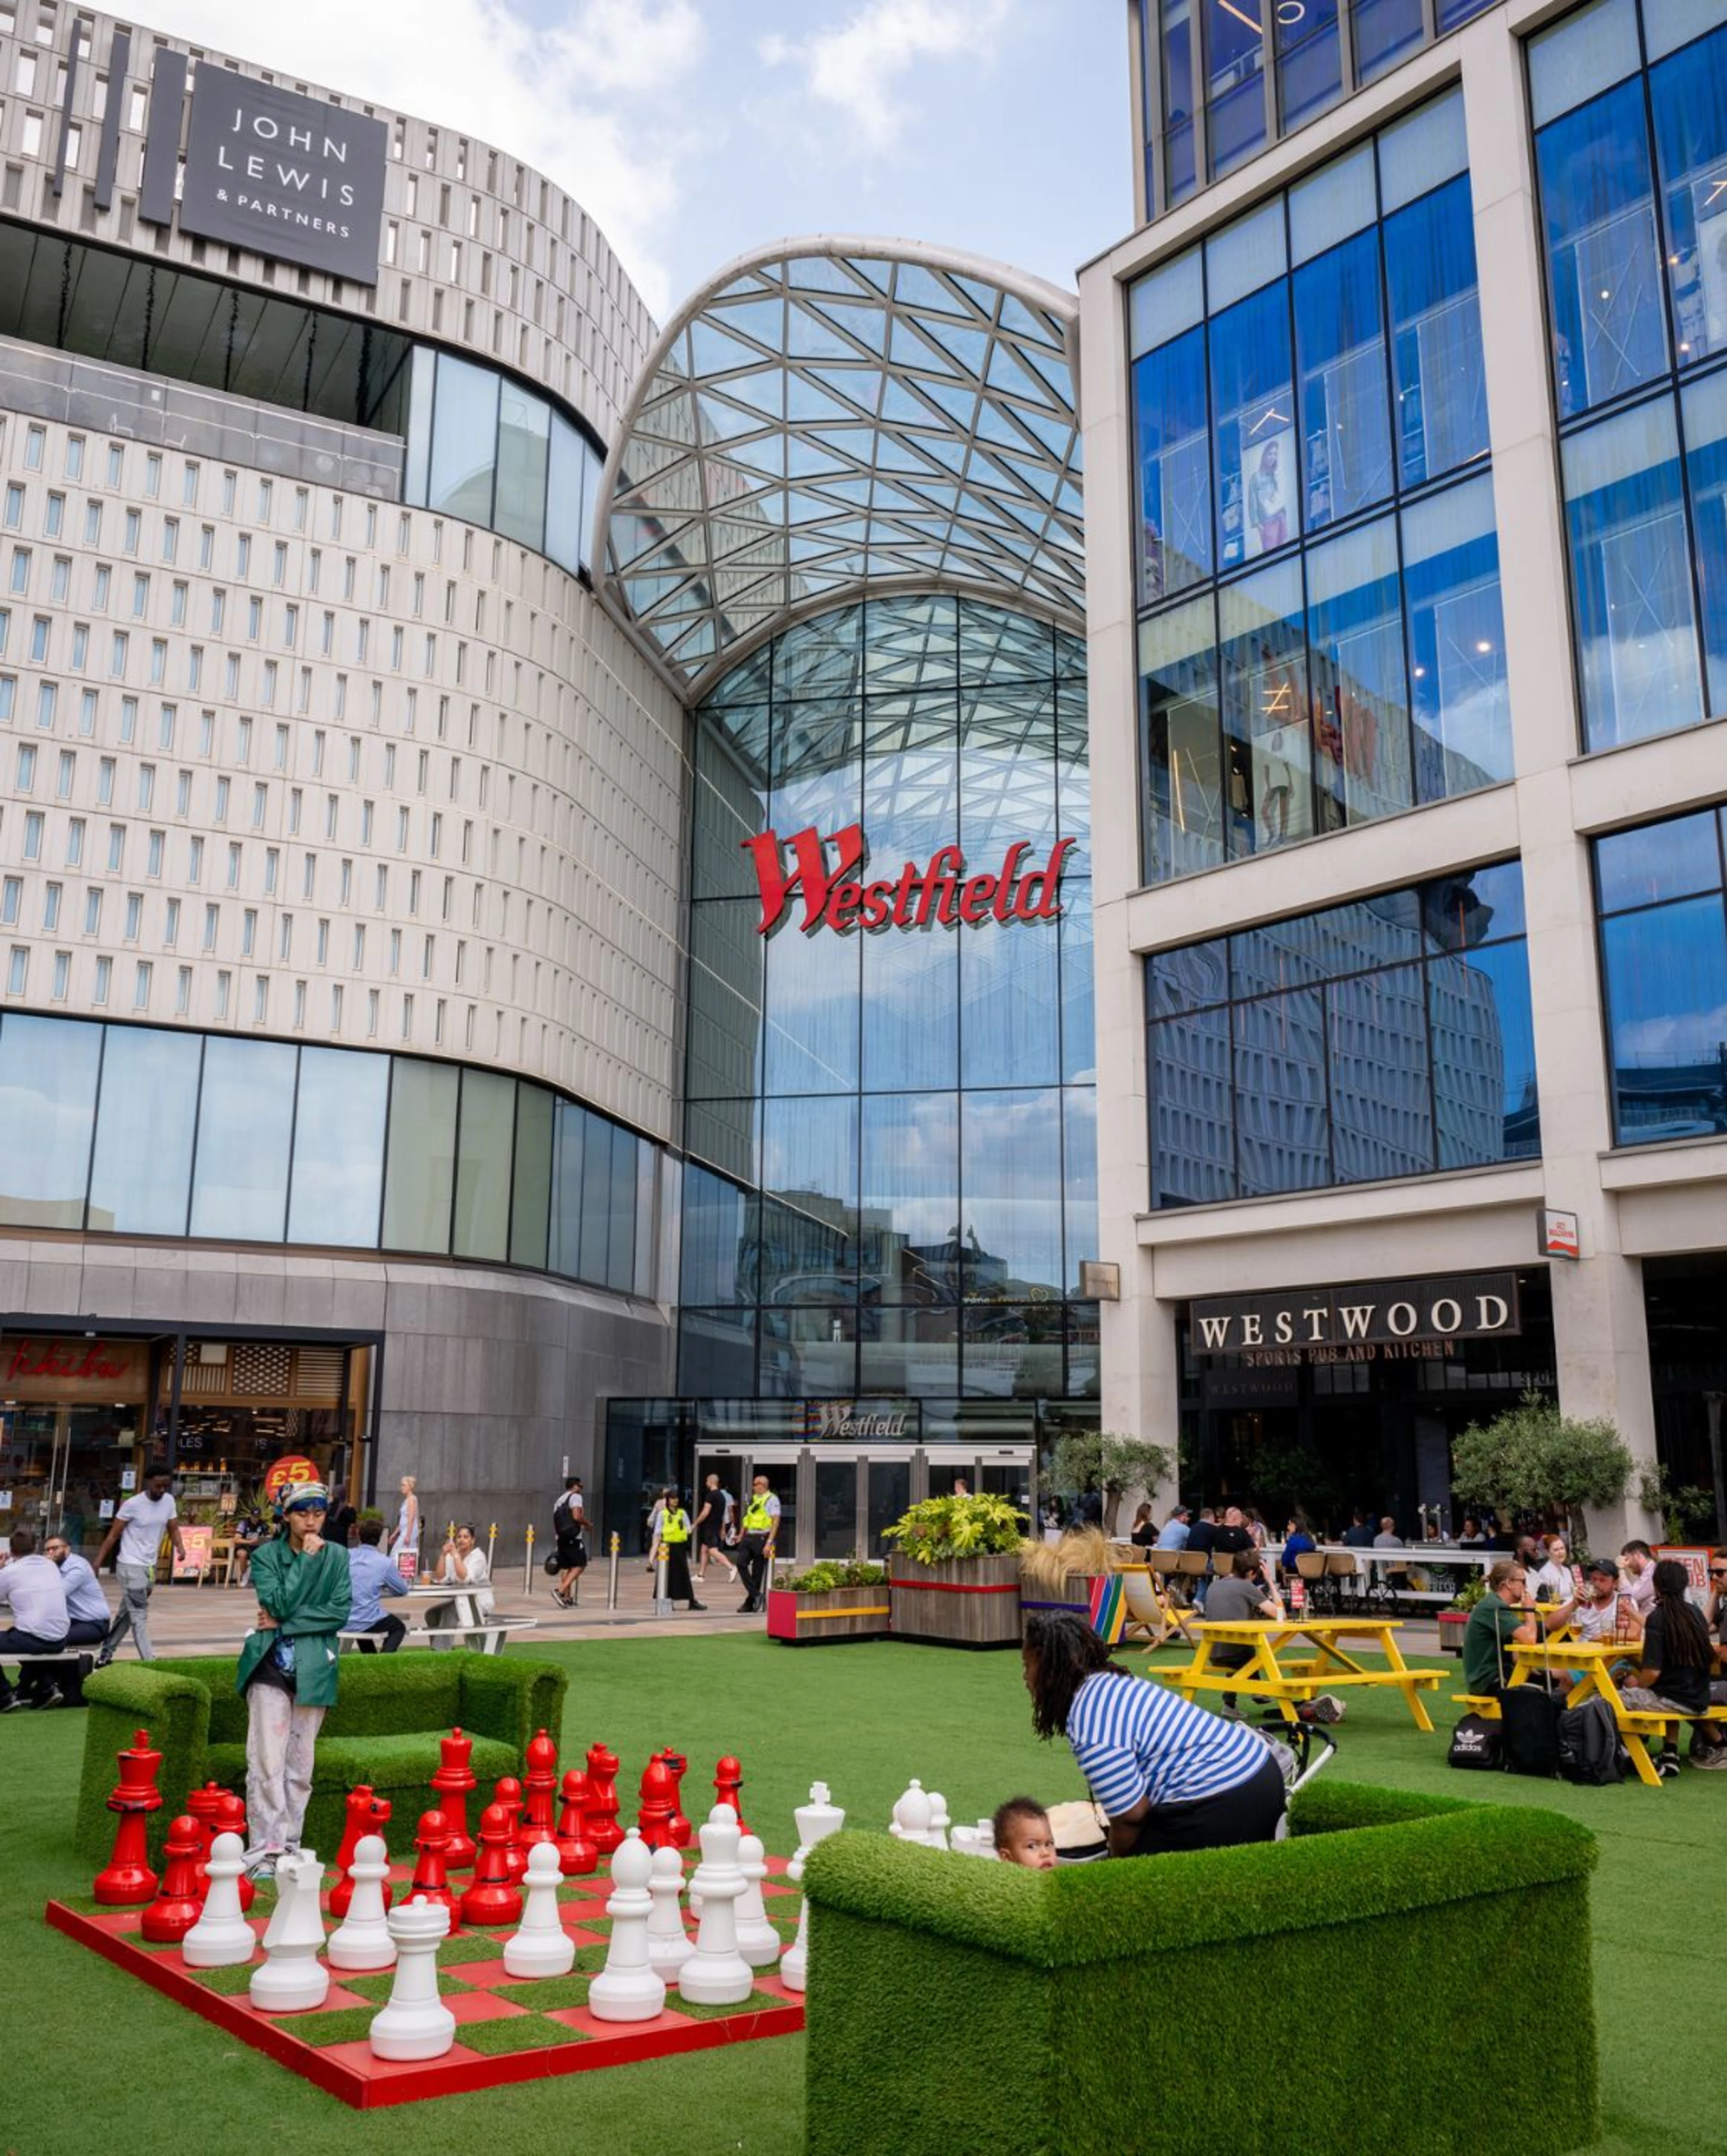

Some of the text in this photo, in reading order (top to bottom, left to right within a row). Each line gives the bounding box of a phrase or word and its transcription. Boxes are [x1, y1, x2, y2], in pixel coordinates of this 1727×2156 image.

[232, 109, 346, 163] JOHN
[218, 145, 354, 206] LEWIS
[217, 189, 350, 238] & PARTNERS
[741, 823, 1077, 935] Westfield
[1198, 1295, 1508, 1349] WESTWOOD
[1245, 1339, 1455, 1367] SPORTS PUB AND KITCHEN
[820, 1403, 907, 1439] Westfield
[271, 1461, 310, 1486] £5
[1454, 1743, 1482, 1752] adidas
